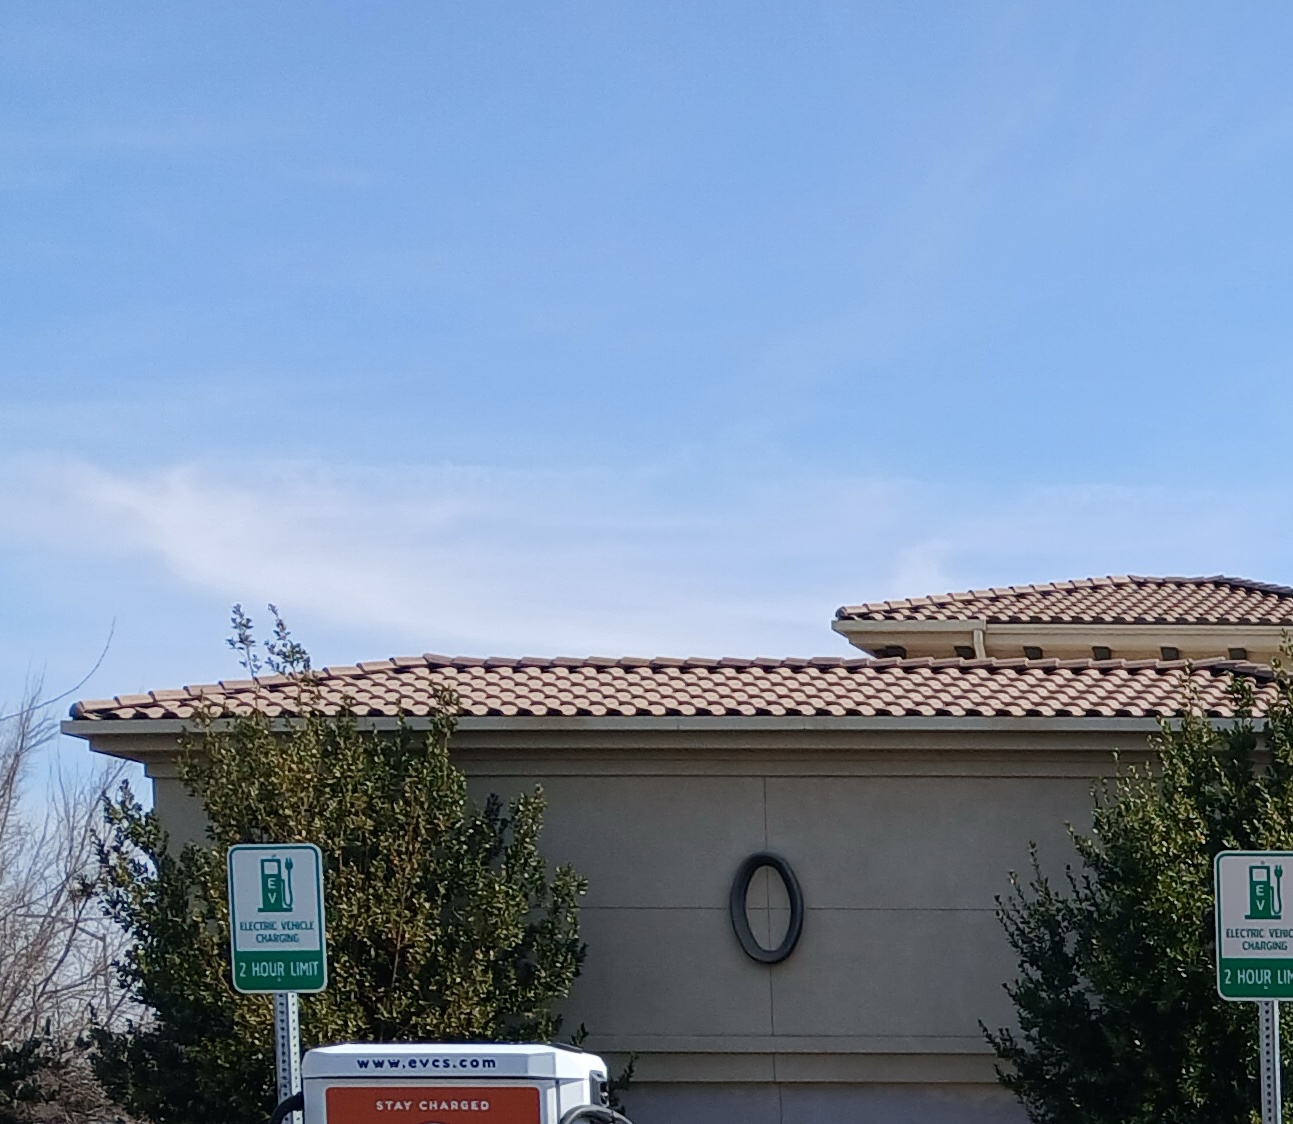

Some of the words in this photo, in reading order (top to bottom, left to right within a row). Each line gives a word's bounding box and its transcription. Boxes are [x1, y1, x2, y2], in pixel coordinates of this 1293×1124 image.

[240, 921, 277, 931] ELECTRIC
[281, 921, 314, 931] VEHICLE
[255, 933, 299, 943] CHARGING
[1225, 928, 1264, 938] ELECTRIC
[1242, 941, 1288, 951] CHARGING
[239, 962, 246, 977] 2
[252, 961, 285, 977] HOUR
[290, 961, 319, 976] LIMIT
[1224, 969, 1232, 985] 2
[1237, 969, 1272, 985] HOUR
[356, 1057, 496, 1069] www.evcs.com
[375, 1101, 412, 1111] STAY
[418, 1101, 490, 1111] CHARGED
